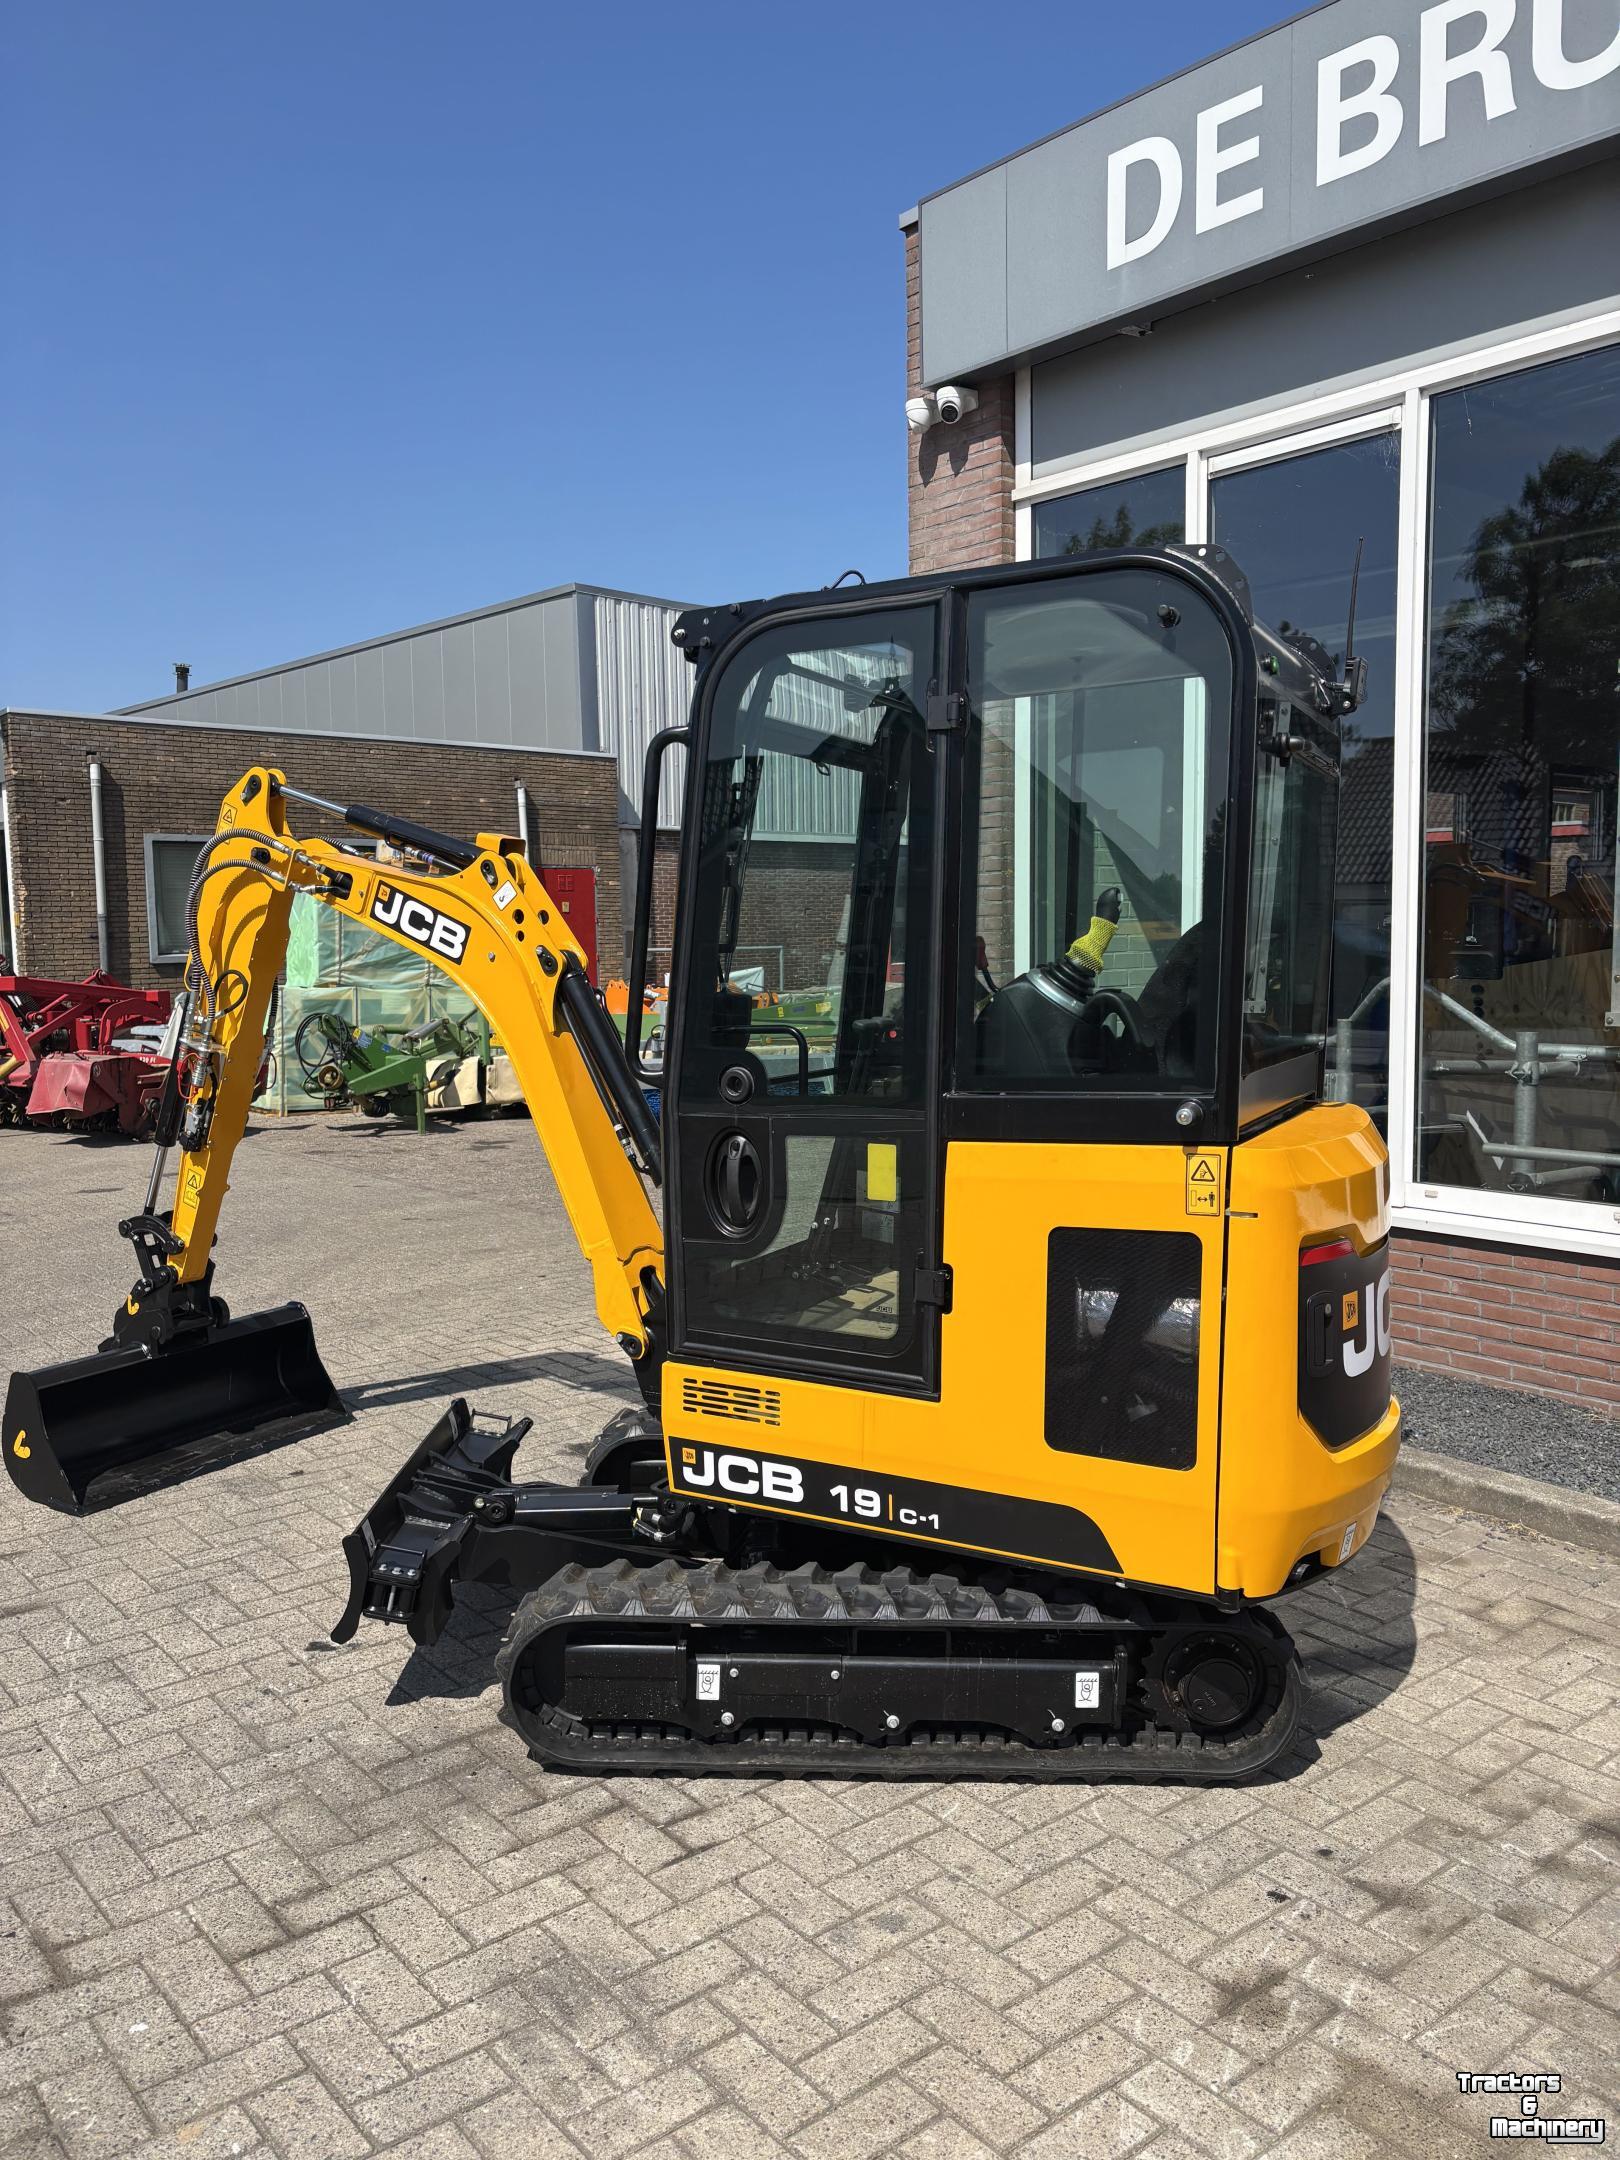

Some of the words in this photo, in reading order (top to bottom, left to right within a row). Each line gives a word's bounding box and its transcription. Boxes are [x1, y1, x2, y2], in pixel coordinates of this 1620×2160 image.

[1107, 85, 1264, 270] DE
[374, 892, 466, 959] JCB
[682, 1450, 804, 1503] JCB
[829, 1484, 880, 1518] 19
[899, 1508, 939, 1530] C-1
